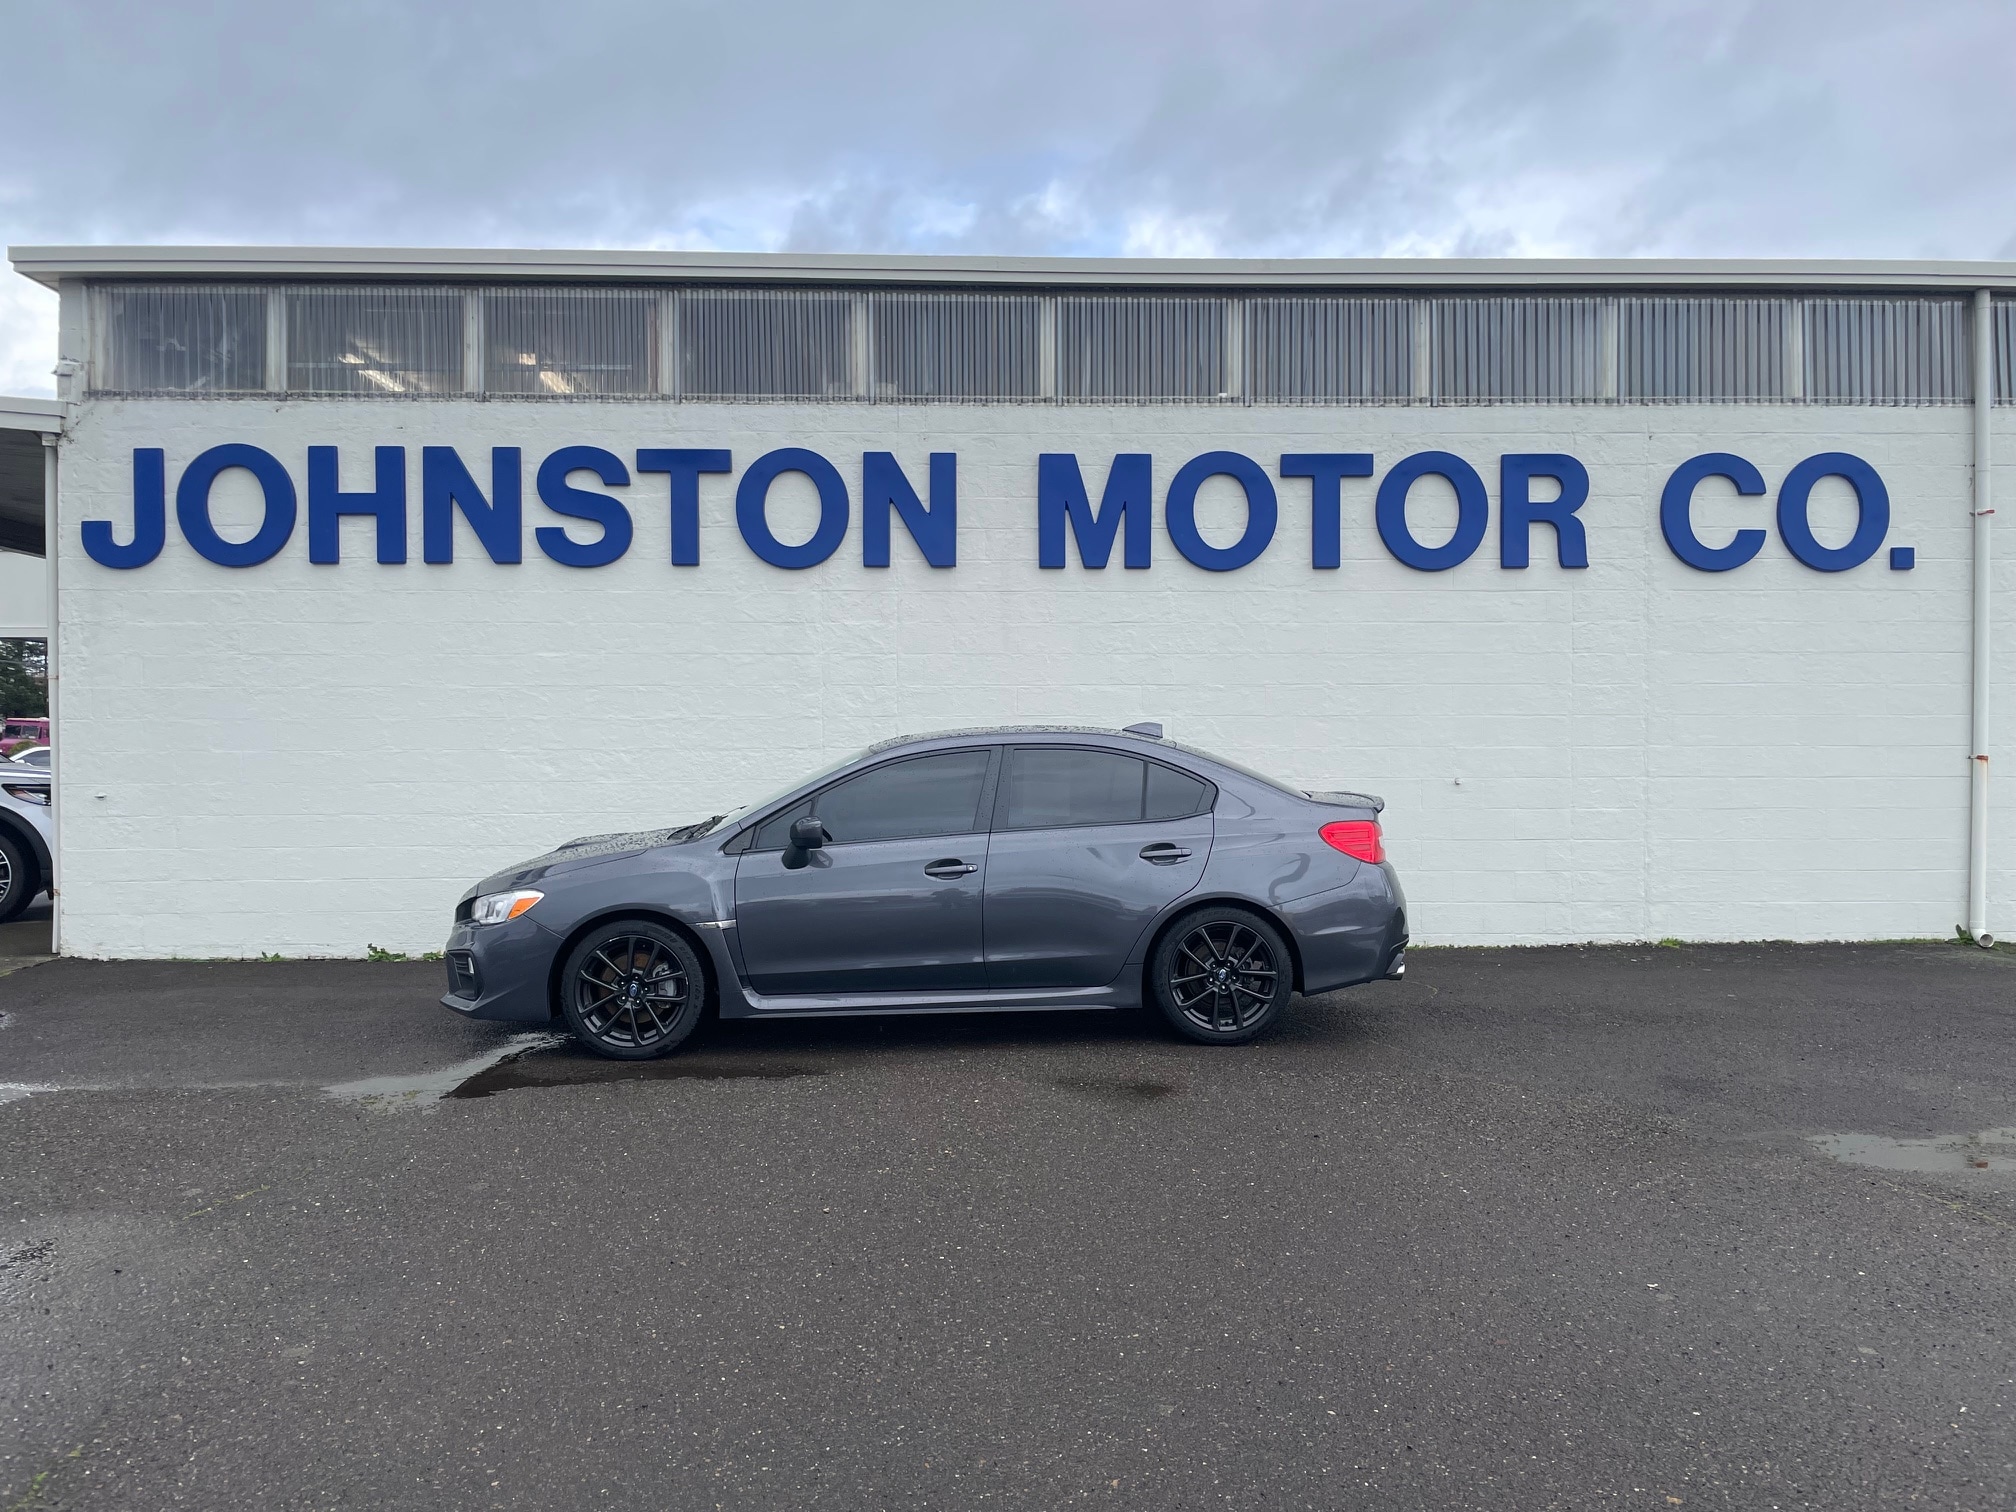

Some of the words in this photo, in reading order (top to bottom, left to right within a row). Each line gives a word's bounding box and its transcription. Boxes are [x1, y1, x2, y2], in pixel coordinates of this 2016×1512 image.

[82, 443, 956, 569] JOHNSTON
[1038, 450, 1589, 571] MOTOR
[1660, 451, 1915, 572] CO.
